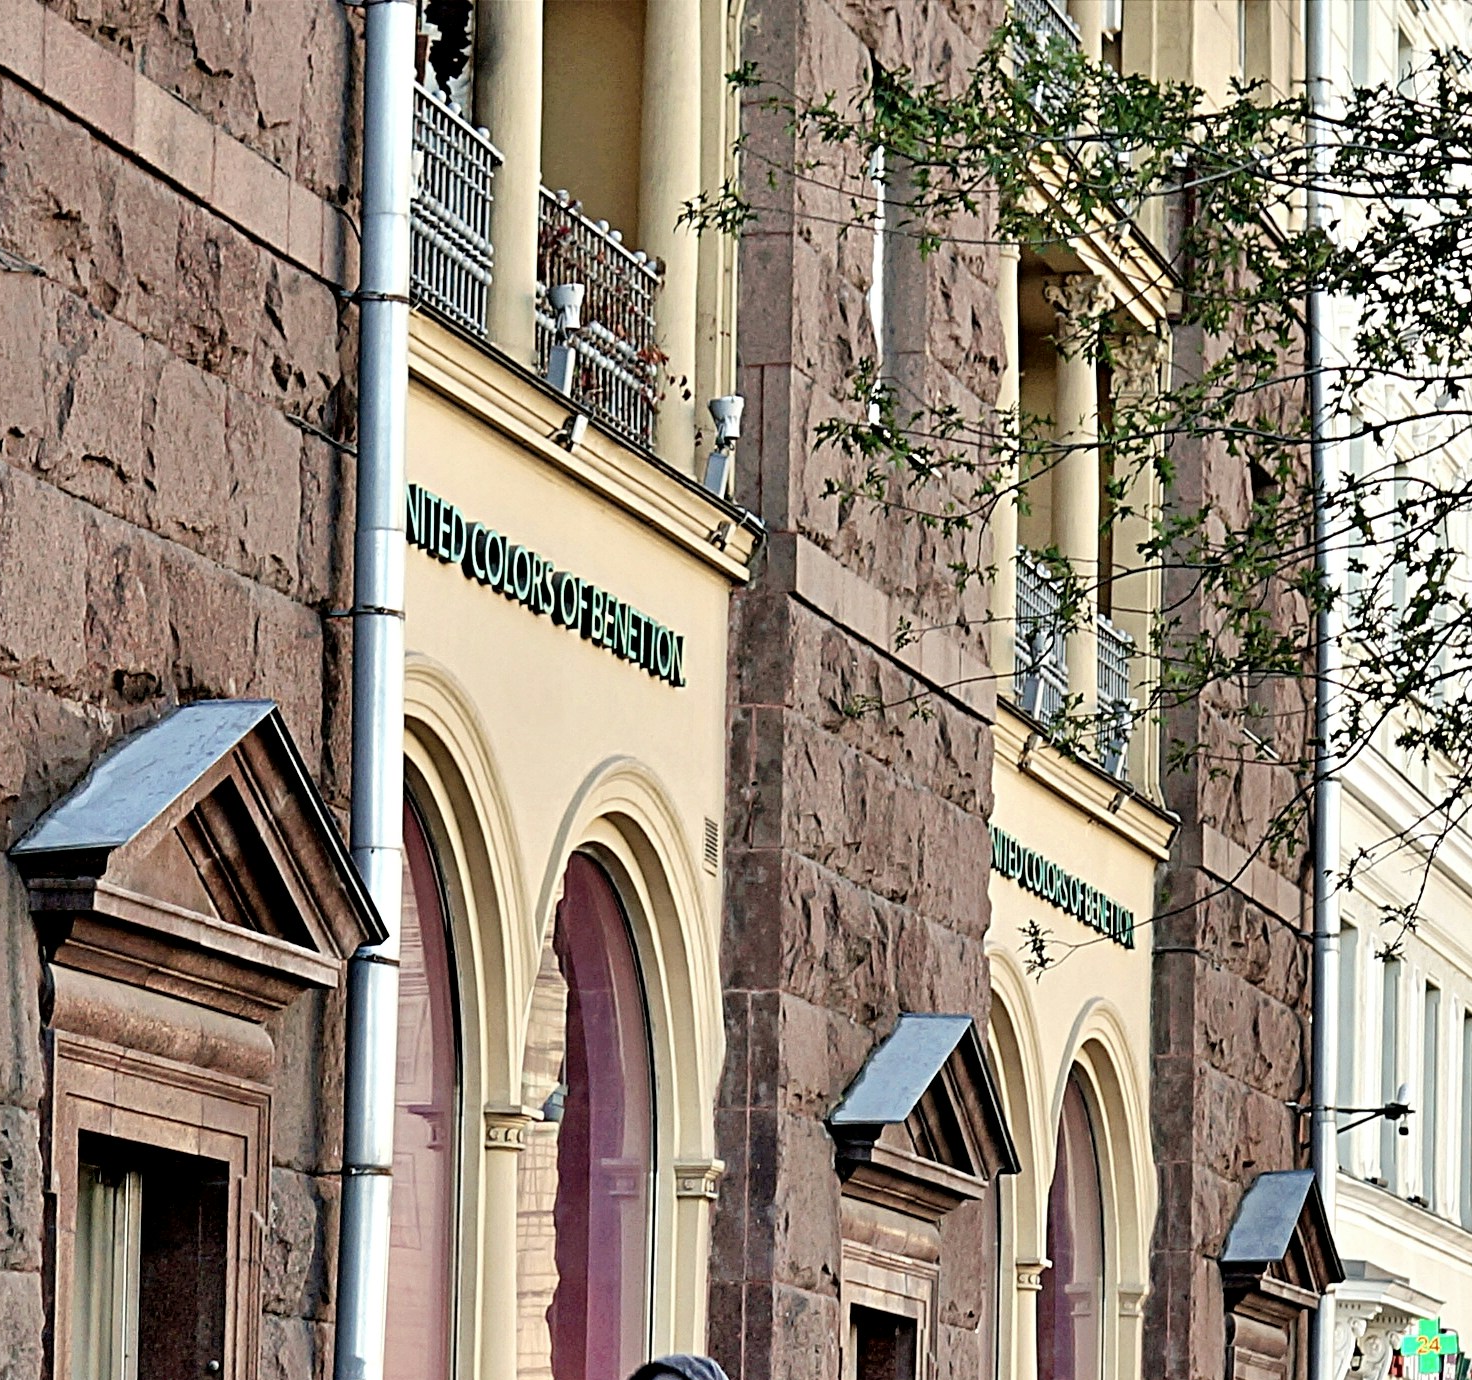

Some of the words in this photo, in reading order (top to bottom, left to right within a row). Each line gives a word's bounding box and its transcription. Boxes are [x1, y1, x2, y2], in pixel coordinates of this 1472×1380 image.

[406, 484, 468, 564] NITED
[468, 521, 555, 616] COLORS
[558, 571, 589, 639] OF
[989, 824, 1023, 880] NITED
[1024, 848, 1069, 909] COLORS
[1069, 874, 1085, 917] OF
[1417, 1336, 1440, 1354] 24
